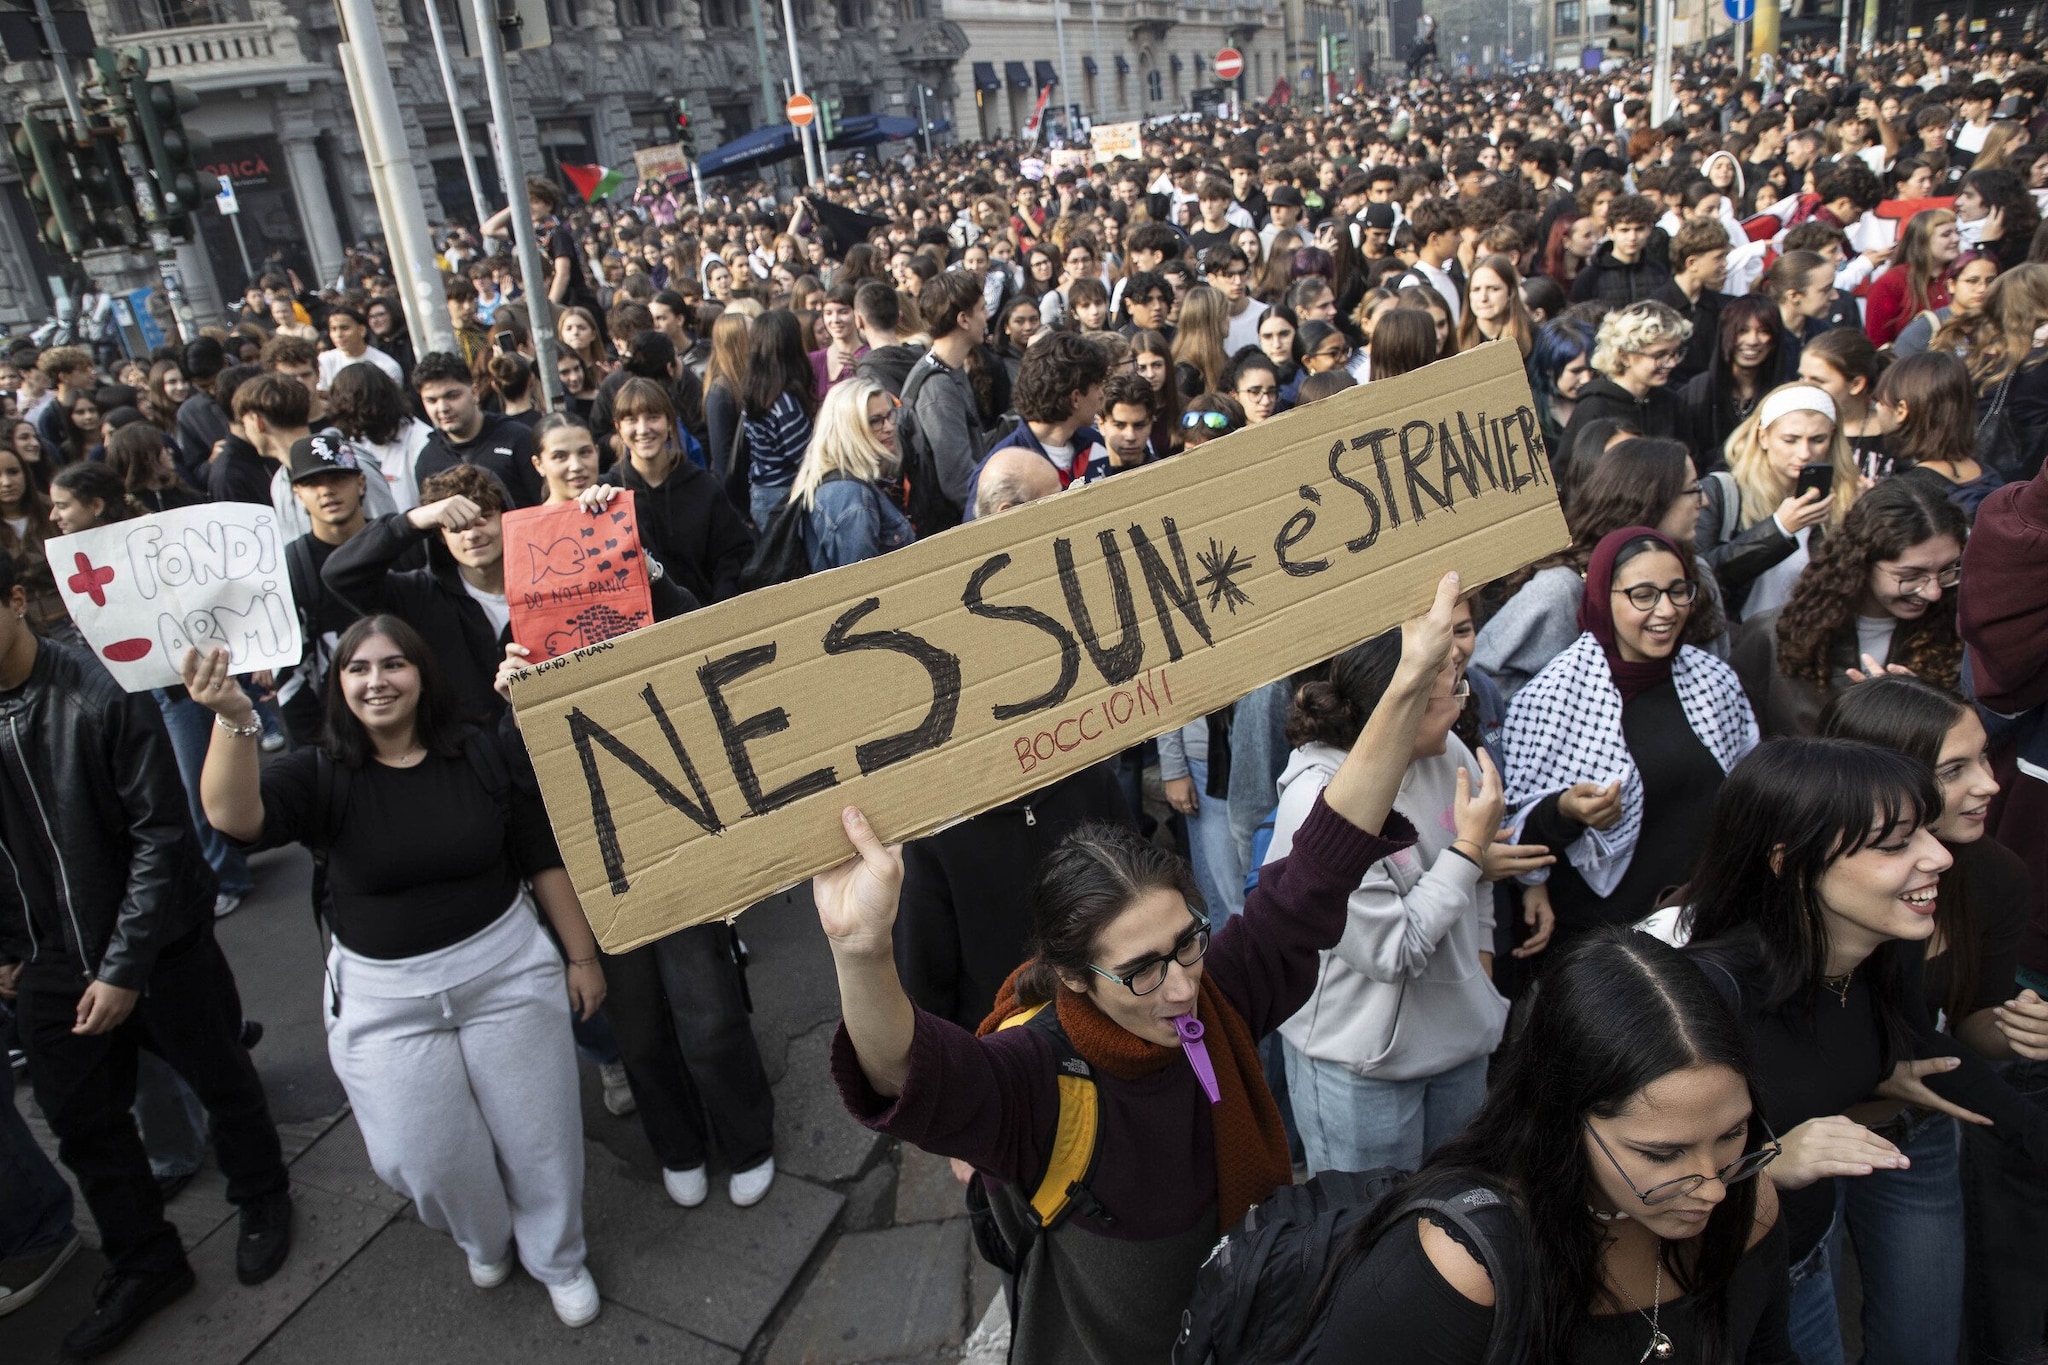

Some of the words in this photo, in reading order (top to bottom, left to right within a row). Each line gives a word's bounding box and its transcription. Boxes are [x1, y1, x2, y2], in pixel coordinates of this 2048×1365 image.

[524, 591, 543, 609] DO
[551, 584, 582, 603] NOT
[589, 577, 629, 596] PANIC
[1014, 669, 1174, 774] BOCCIONI
